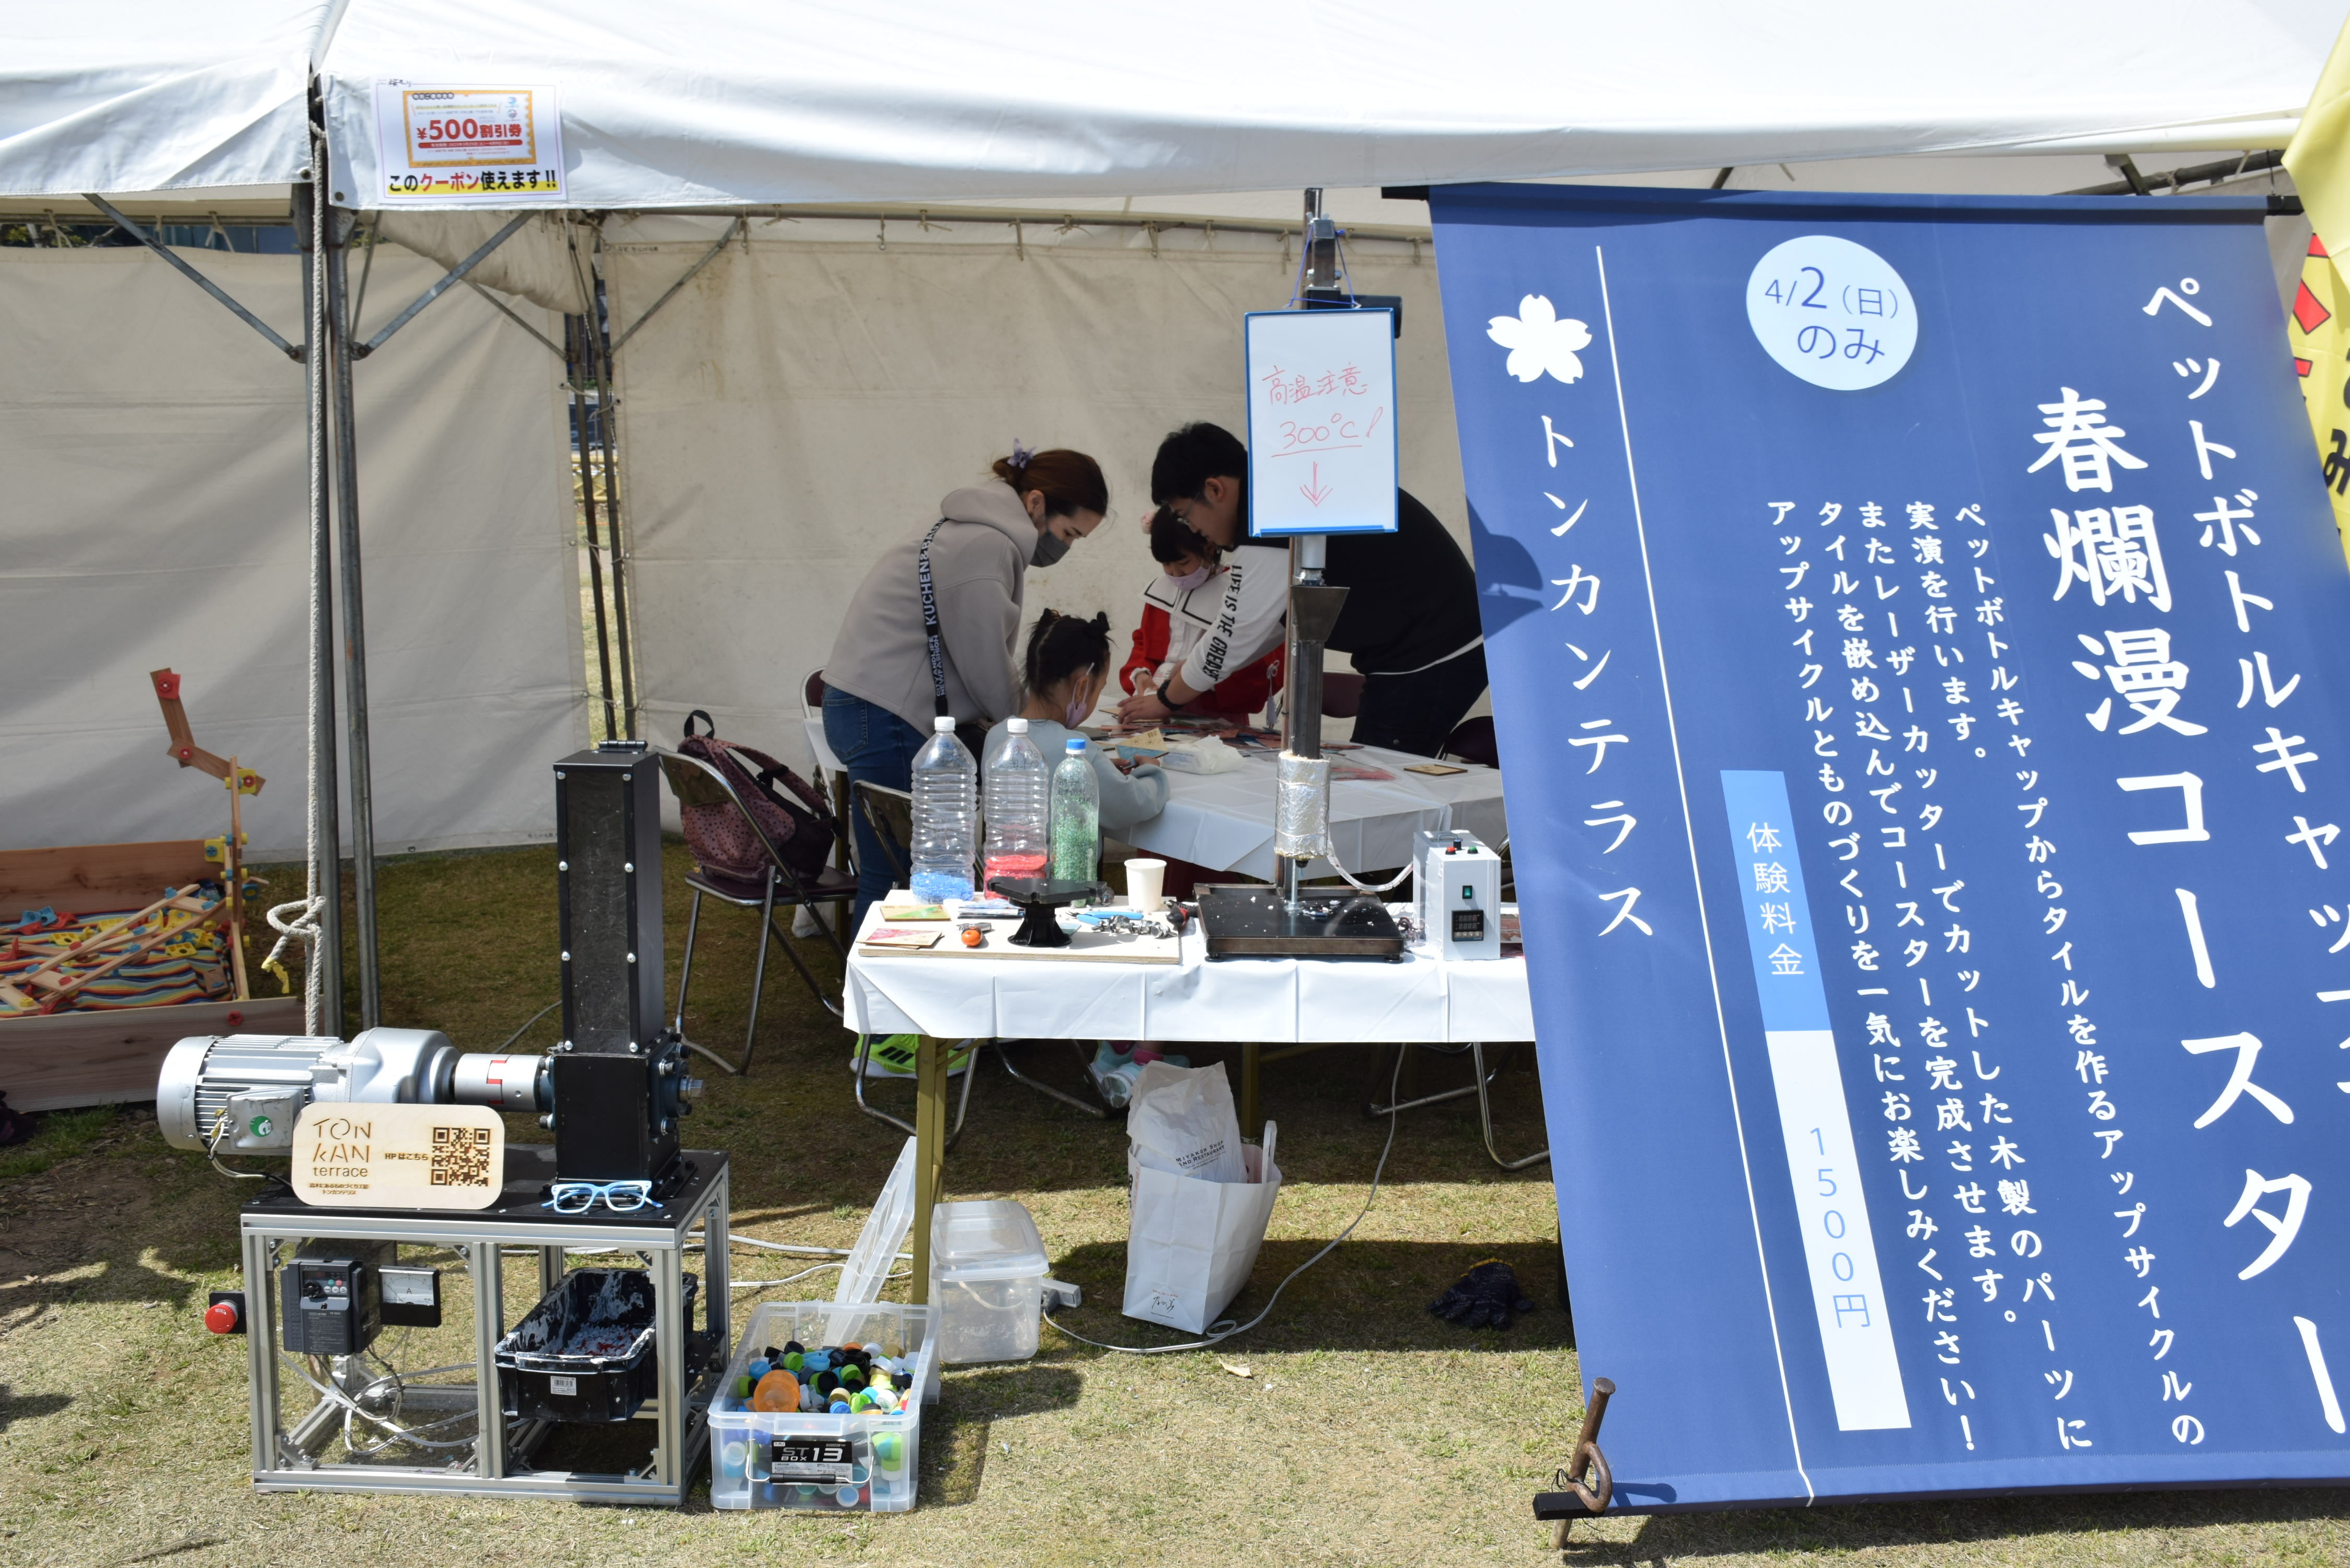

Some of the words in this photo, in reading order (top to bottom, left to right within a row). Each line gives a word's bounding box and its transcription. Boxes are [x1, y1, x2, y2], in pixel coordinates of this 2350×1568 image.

[1798, 325, 1885, 365] のみ
[1262, 362, 1368, 405] 高温注意
[1228, 564, 1242, 594] LIFE
[1225, 594, 1238, 612] IS
[1217, 614, 1235, 638] THE
[1906, 501, 1986, 758] 実演を行います。
[1540, 414, 1653, 937] トンカンテラス
[1745, 821, 1804, 977] 体験料金
[2028, 387, 2346, 1434] 春爛漫コースター
[1859, 501, 2092, 1449] またレーザーカッターでカットした木製のパーツに
[1955, 503, 2205, 1445] ペットボトルキャップからタイルを作るアップサイクルの
[313, 1118, 371, 1140] TON
[313, 1166, 368, 1178] terrace
[1809, 1127, 1871, 1329] 1500円
[782, 1447, 809, 1456] ST
[813, 1447, 843, 1461] 13
